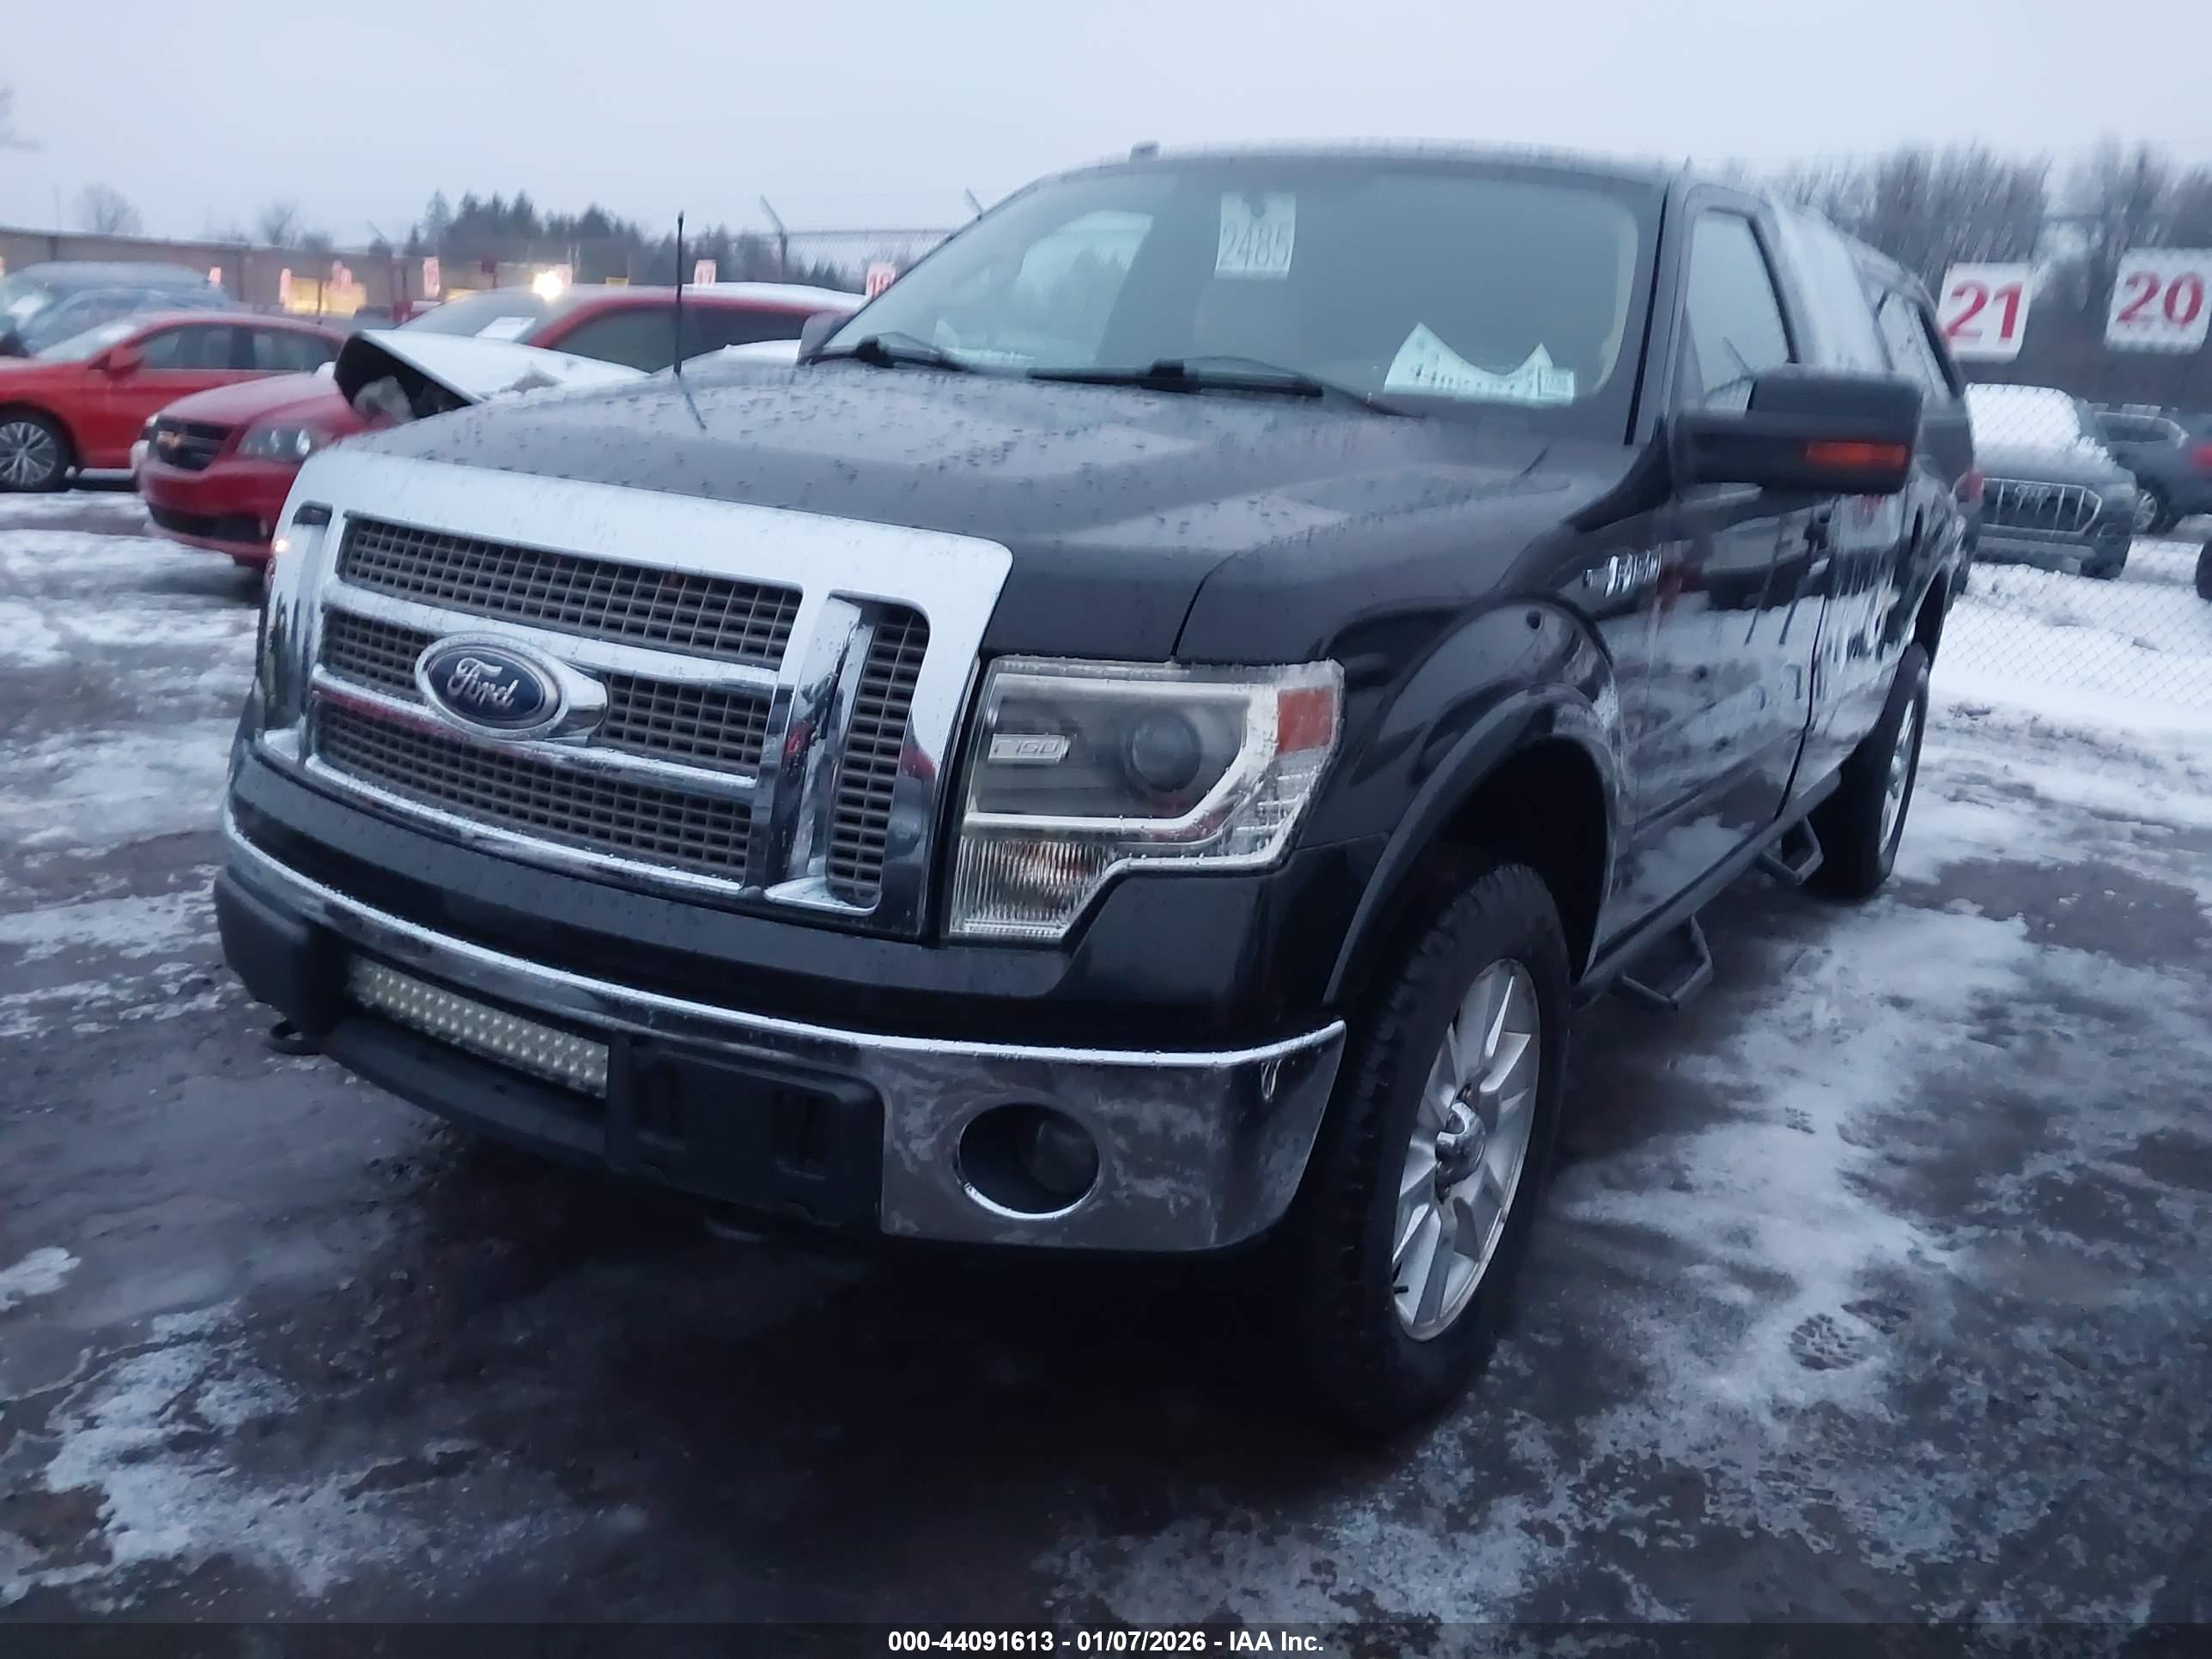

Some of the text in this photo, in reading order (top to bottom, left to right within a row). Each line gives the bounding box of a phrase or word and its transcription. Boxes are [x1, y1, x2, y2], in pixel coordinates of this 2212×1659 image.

[1945, 280, 2023, 338] 21
[2117, 270, 2204, 325] 20
[447, 657, 520, 708] Ford
